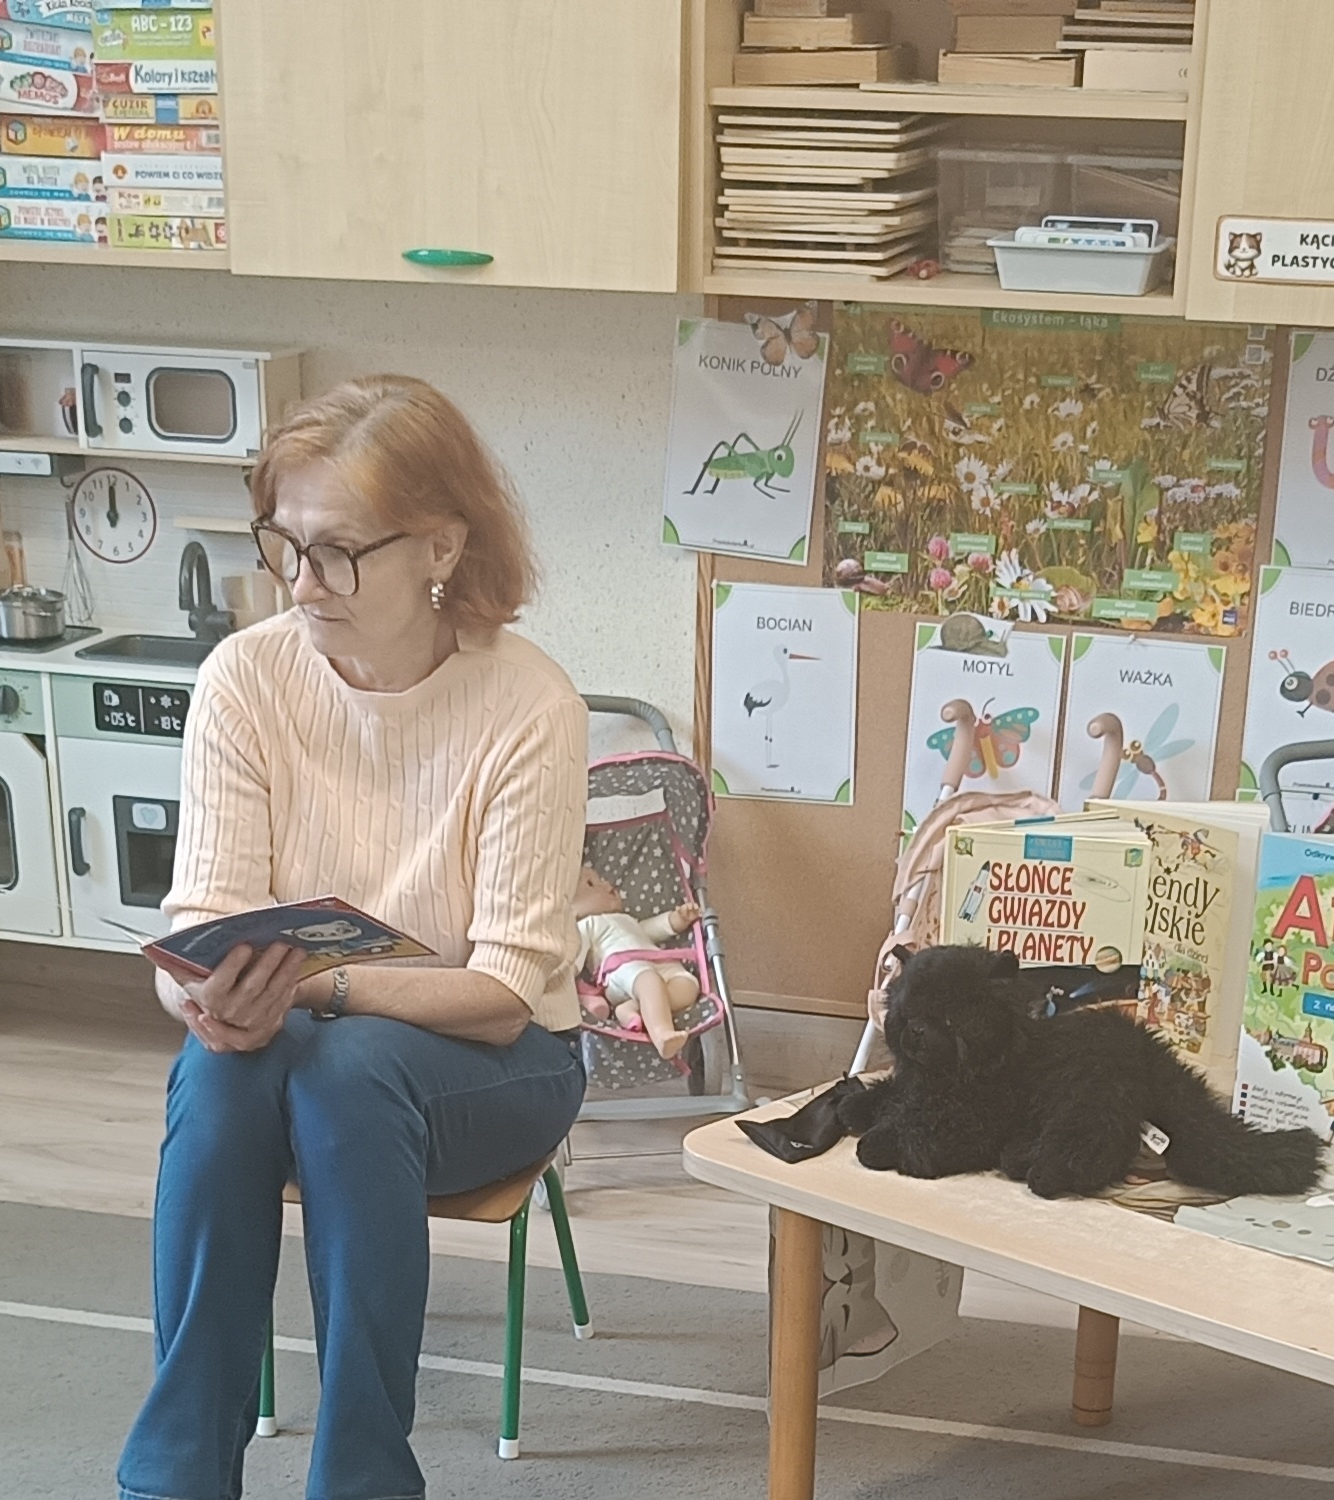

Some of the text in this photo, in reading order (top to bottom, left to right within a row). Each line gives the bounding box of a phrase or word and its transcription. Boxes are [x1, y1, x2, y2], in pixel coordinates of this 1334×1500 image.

[131, 14, 157, 32] ABC
[170, 15, 193, 32] 123
[134, 65, 172, 86] Kolory
[113, 125, 186, 141] W domu
[135, 170, 170, 180] POWIEM
[992, 311, 1064, 326] Ekosystem
[699, 355, 802, 379] KONIK POLNY
[756, 616, 812, 632] BOCIAN
[962, 659, 1014, 677] MOTYL
[1119, 669, 1173, 687] WAŻKA
[989, 860, 1074, 896] SŁOŃCE
[1148, 875, 1220, 919] endy
[988, 895, 1086, 930] GWIAZDY
[1145, 894, 1206, 946] lskie
[997, 930, 1094, 965] PLANETY
